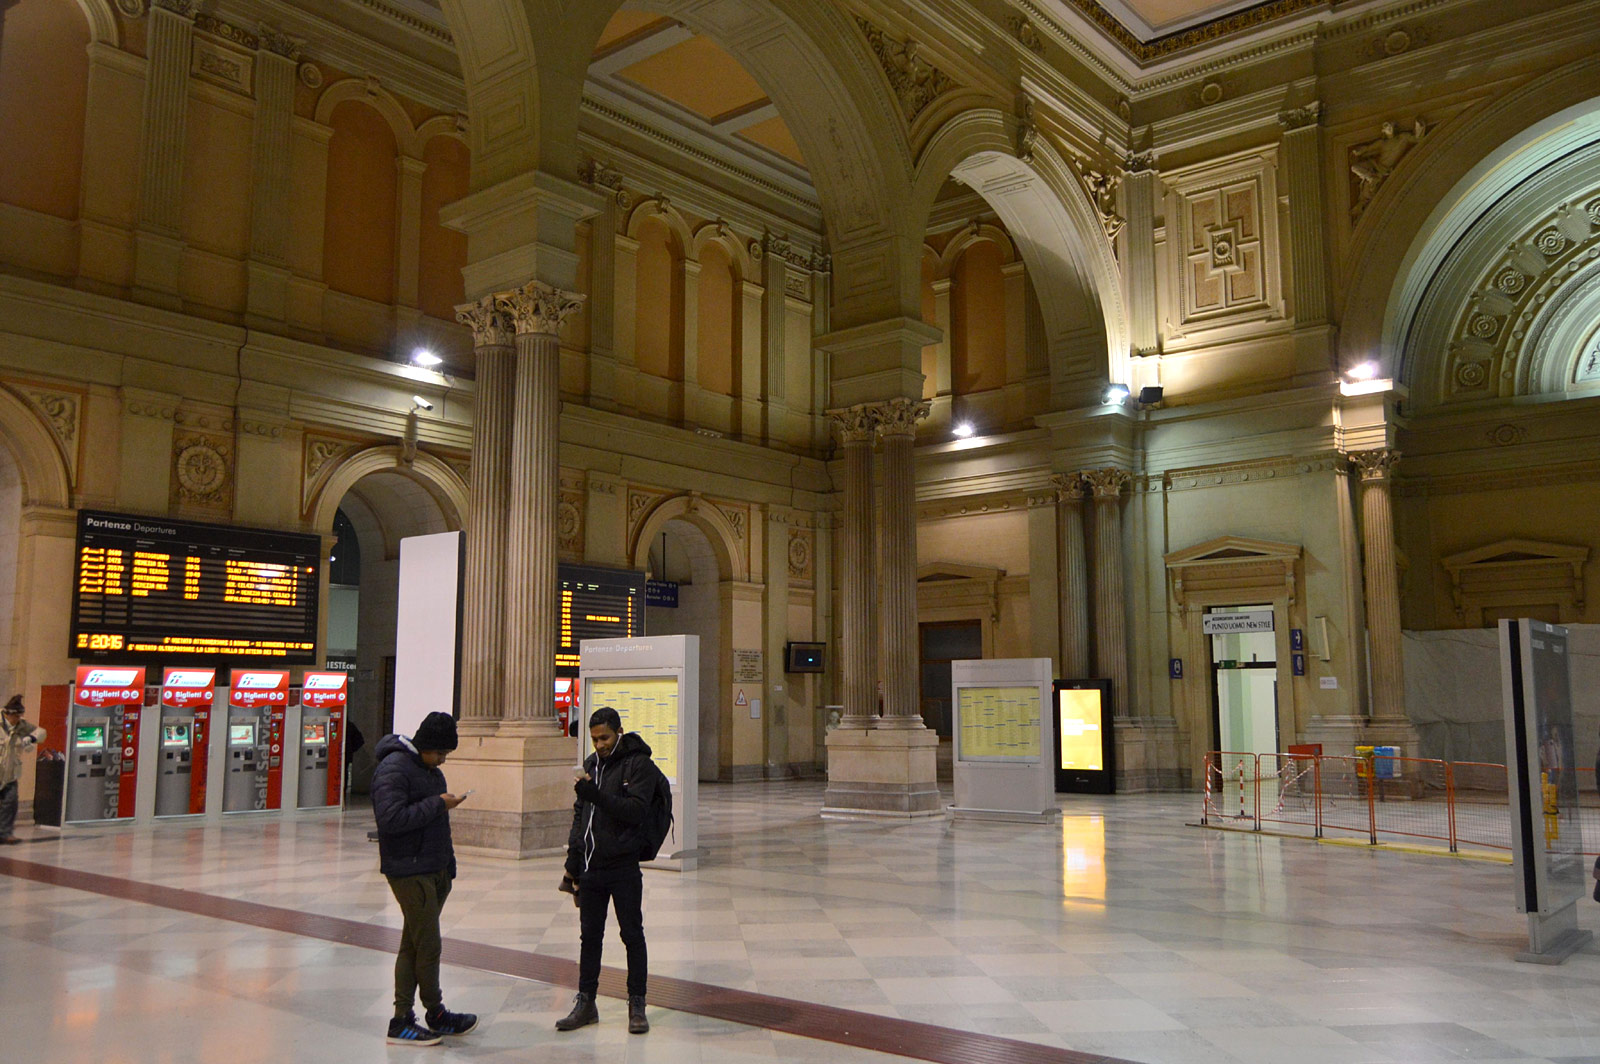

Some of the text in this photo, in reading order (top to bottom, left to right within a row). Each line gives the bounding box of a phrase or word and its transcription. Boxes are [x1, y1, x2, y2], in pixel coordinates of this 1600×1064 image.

[86, 517, 177, 535] Partenze Departures
[89, 634, 124, 650] 20:15
[584, 644, 653, 654] Partenze Departures
[92, 690, 120, 698] Biglietti
[175, 691, 202, 699] Biglietti
[244, 692, 268, 700] Biglietti
[314, 692, 336, 700] Biglietti
[104, 704, 124, 818] Self Service
[255, 706, 271, 810] Self Service
